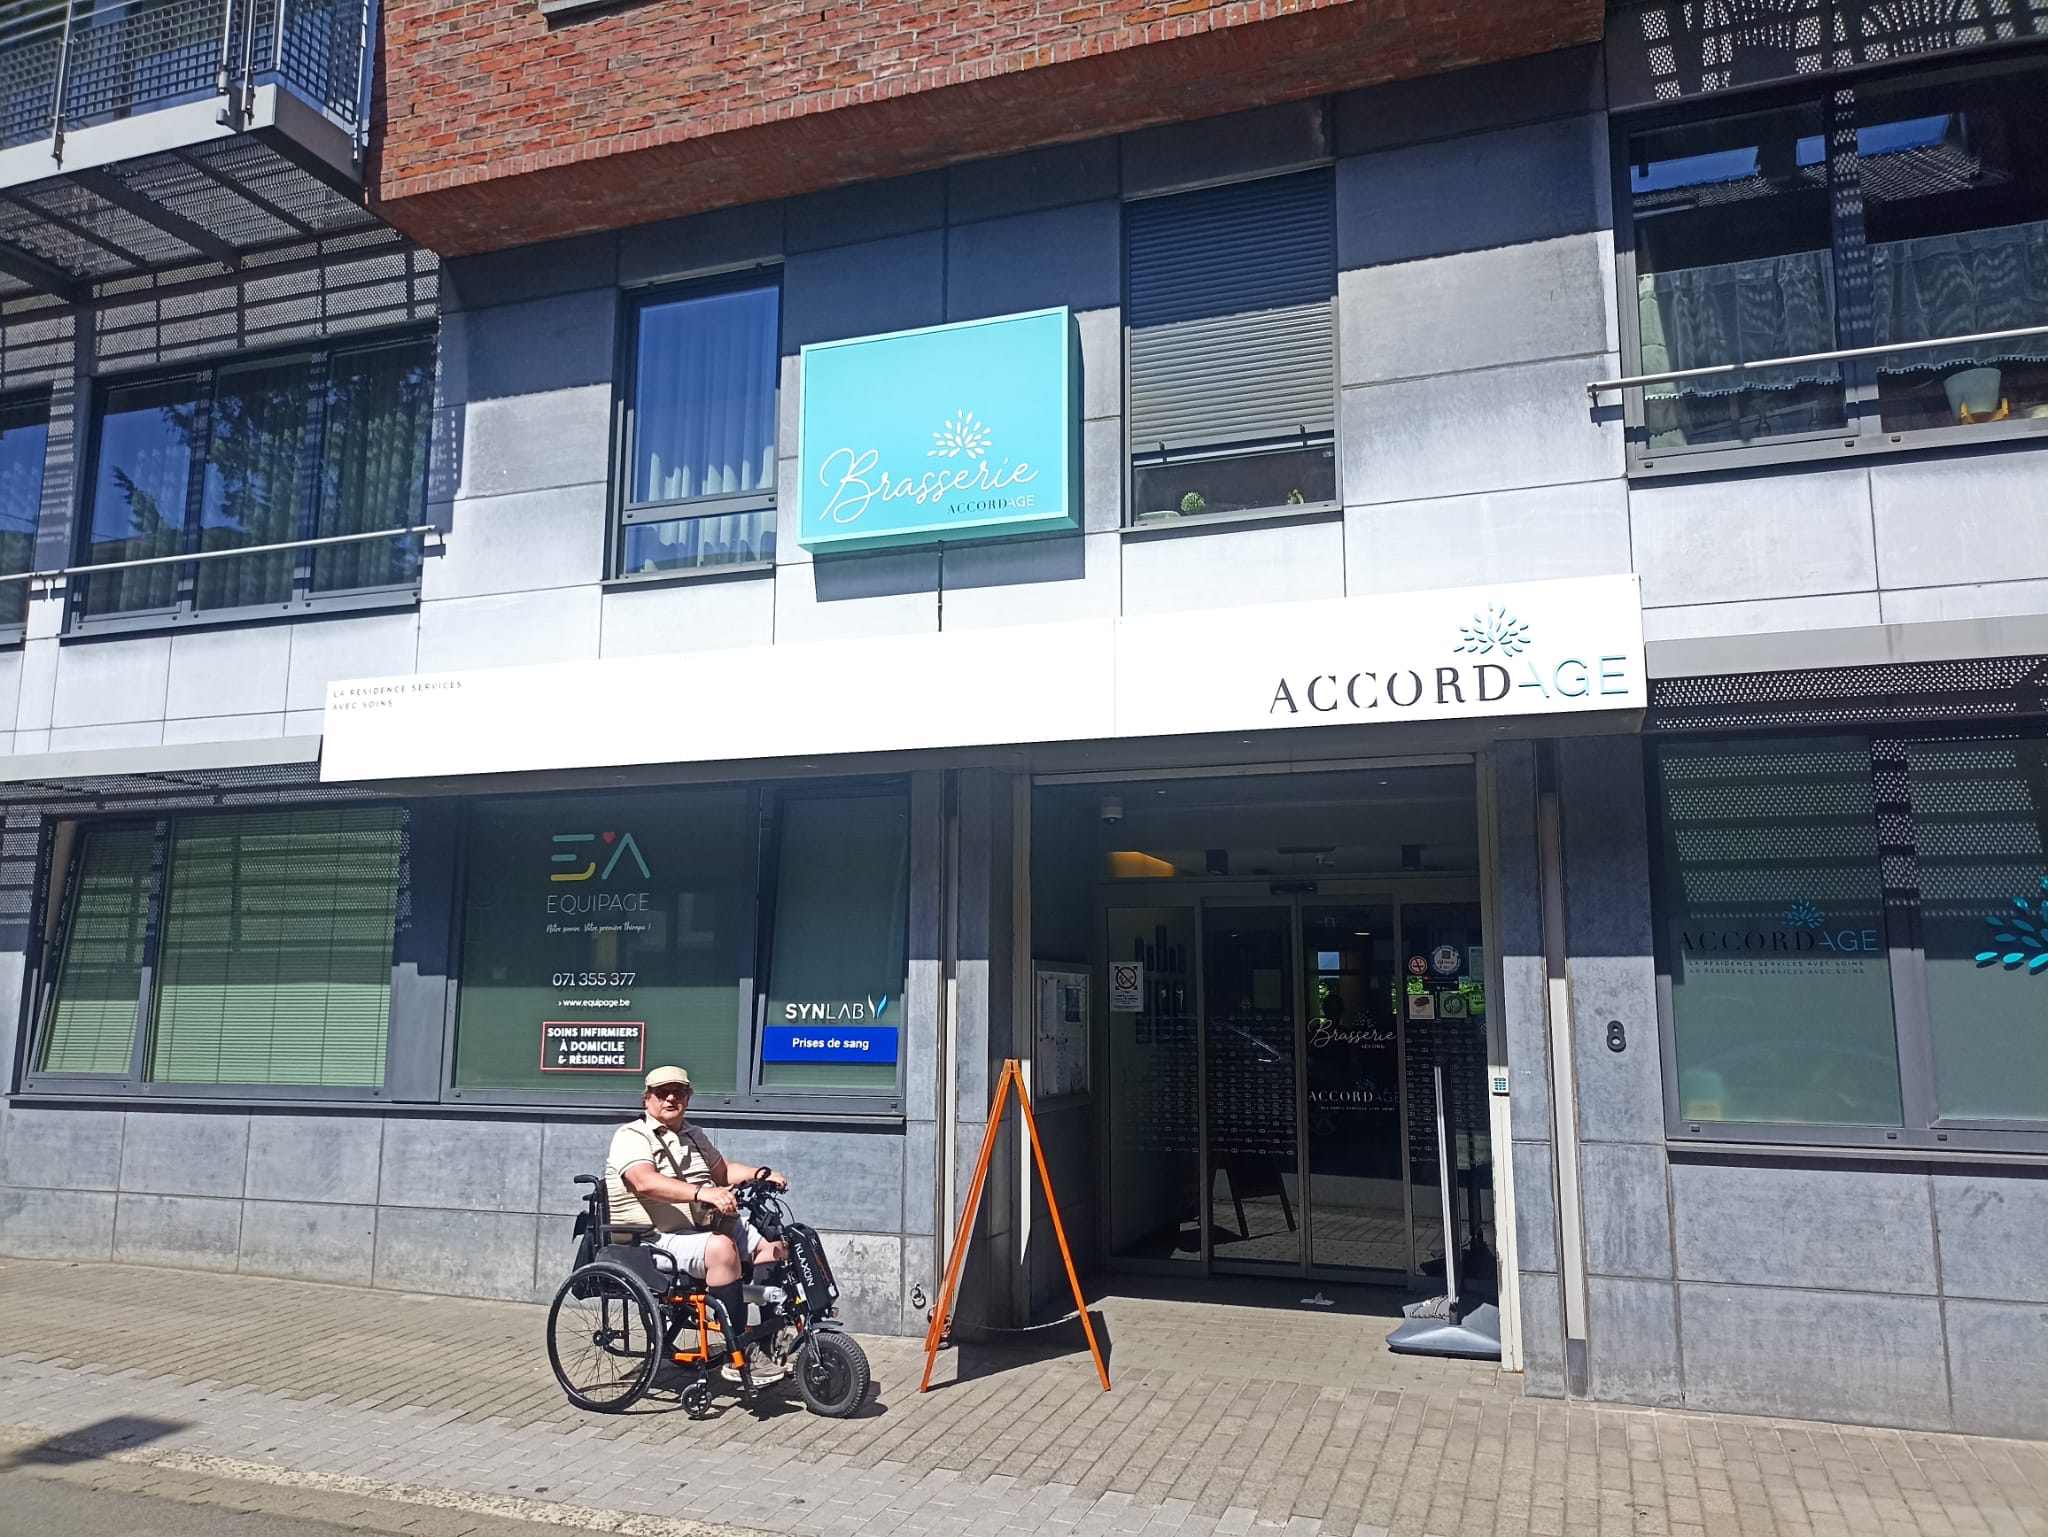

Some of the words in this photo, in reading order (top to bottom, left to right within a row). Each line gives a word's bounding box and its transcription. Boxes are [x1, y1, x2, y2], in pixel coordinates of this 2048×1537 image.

[819, 447, 1039, 524] Brasserie
[948, 494, 1035, 515] ACCORDAGE
[333, 690, 345, 698] LA
[412, 680, 462, 692] SERVICES
[1269, 654, 1630, 714] ACCORDAGE
[333, 702, 357, 711] AVEC
[362, 699, 393, 709] SOINS
[546, 892, 650, 916] EQUIPAGE
[552, 972, 576, 987] 071
[578, 972, 607, 986] 355
[609, 972, 636, 986] 377
[563, 998, 631, 1009] www.equipage.be
[785, 1003, 864, 1020] SYNLAB
[547, 1028, 578, 1037] SOINS
[580, 1027, 639, 1037] INFIRMIERS
[1307, 1017, 1397, 1048] Brasserie
[1606, 1020, 1627, 1053] 8
[559, 1038, 568, 1051] À
[570, 1041, 625, 1052] DOMICILE
[792, 1037, 825, 1048] Prises
[827, 1037, 841, 1048] de
[843, 1039, 870, 1051] sang
[569, 1053, 626, 1065] RÉSIDENCE
[794, 1242, 815, 1287] KLAXON
